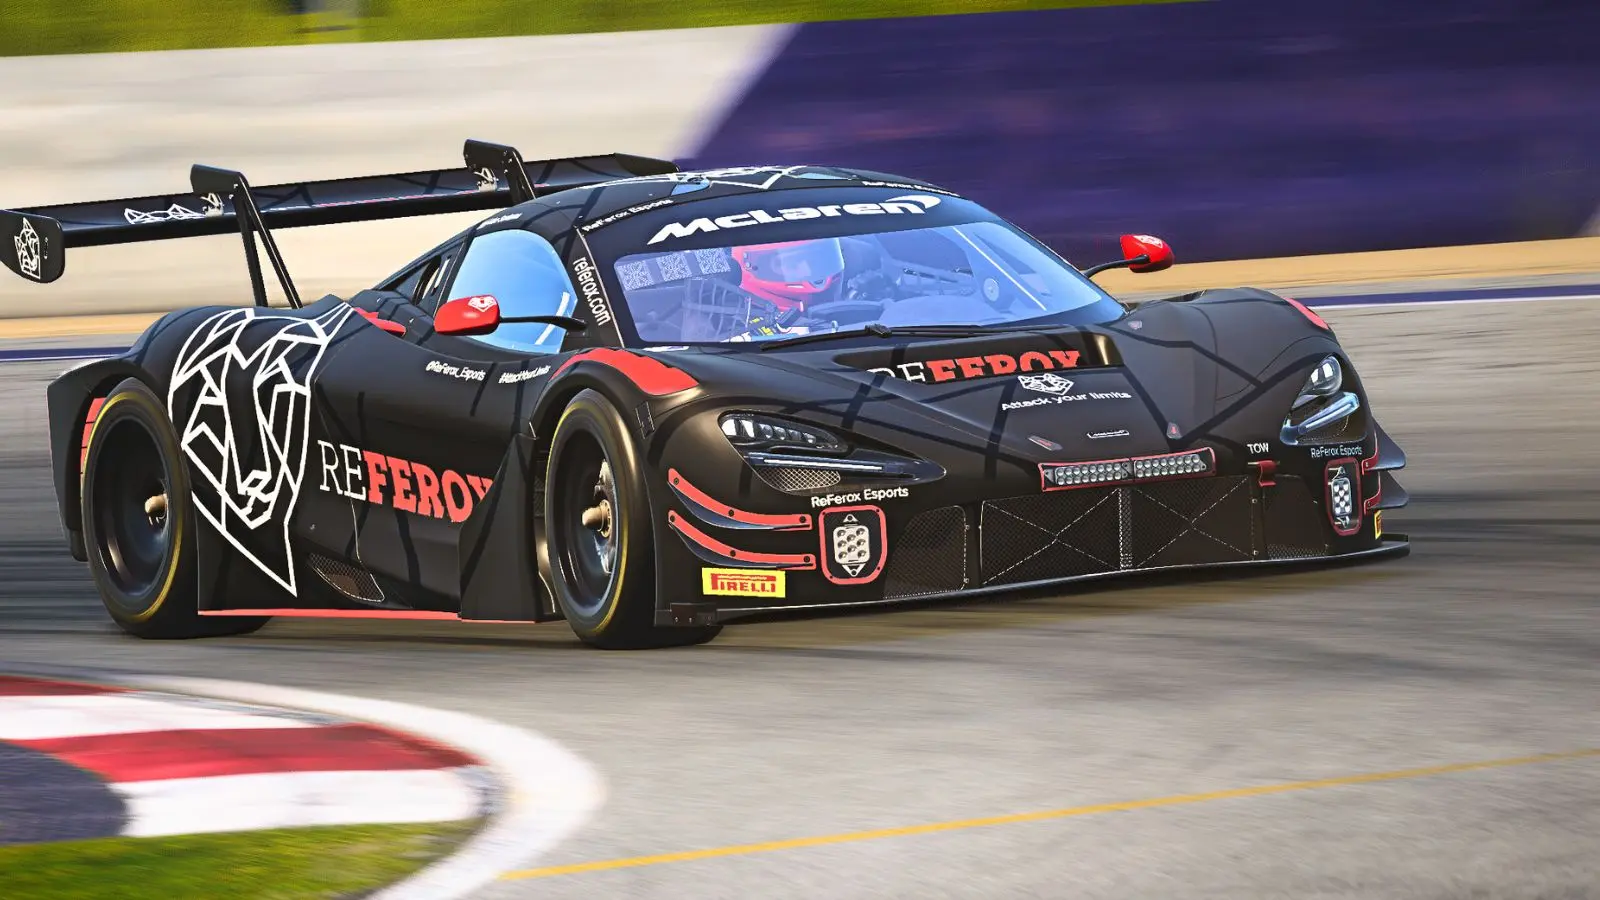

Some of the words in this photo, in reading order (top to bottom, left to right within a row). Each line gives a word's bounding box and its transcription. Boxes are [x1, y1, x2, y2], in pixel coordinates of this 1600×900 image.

[647, 196, 931, 245] McLaren
[572, 256, 611, 326] referox.com
[1001, 397, 1052, 411] Attack
[1051, 394, 1088, 404] your
[1089, 391, 1132, 400] limits
[1247, 442, 1269, 454] TOW
[1310, 447, 1339, 459] ReFerox
[1340, 444, 1363, 456] Esports
[811, 493, 861, 508] ReFerox
[863, 486, 909, 501] Esports
[710, 573, 777, 593] PIRELLI
